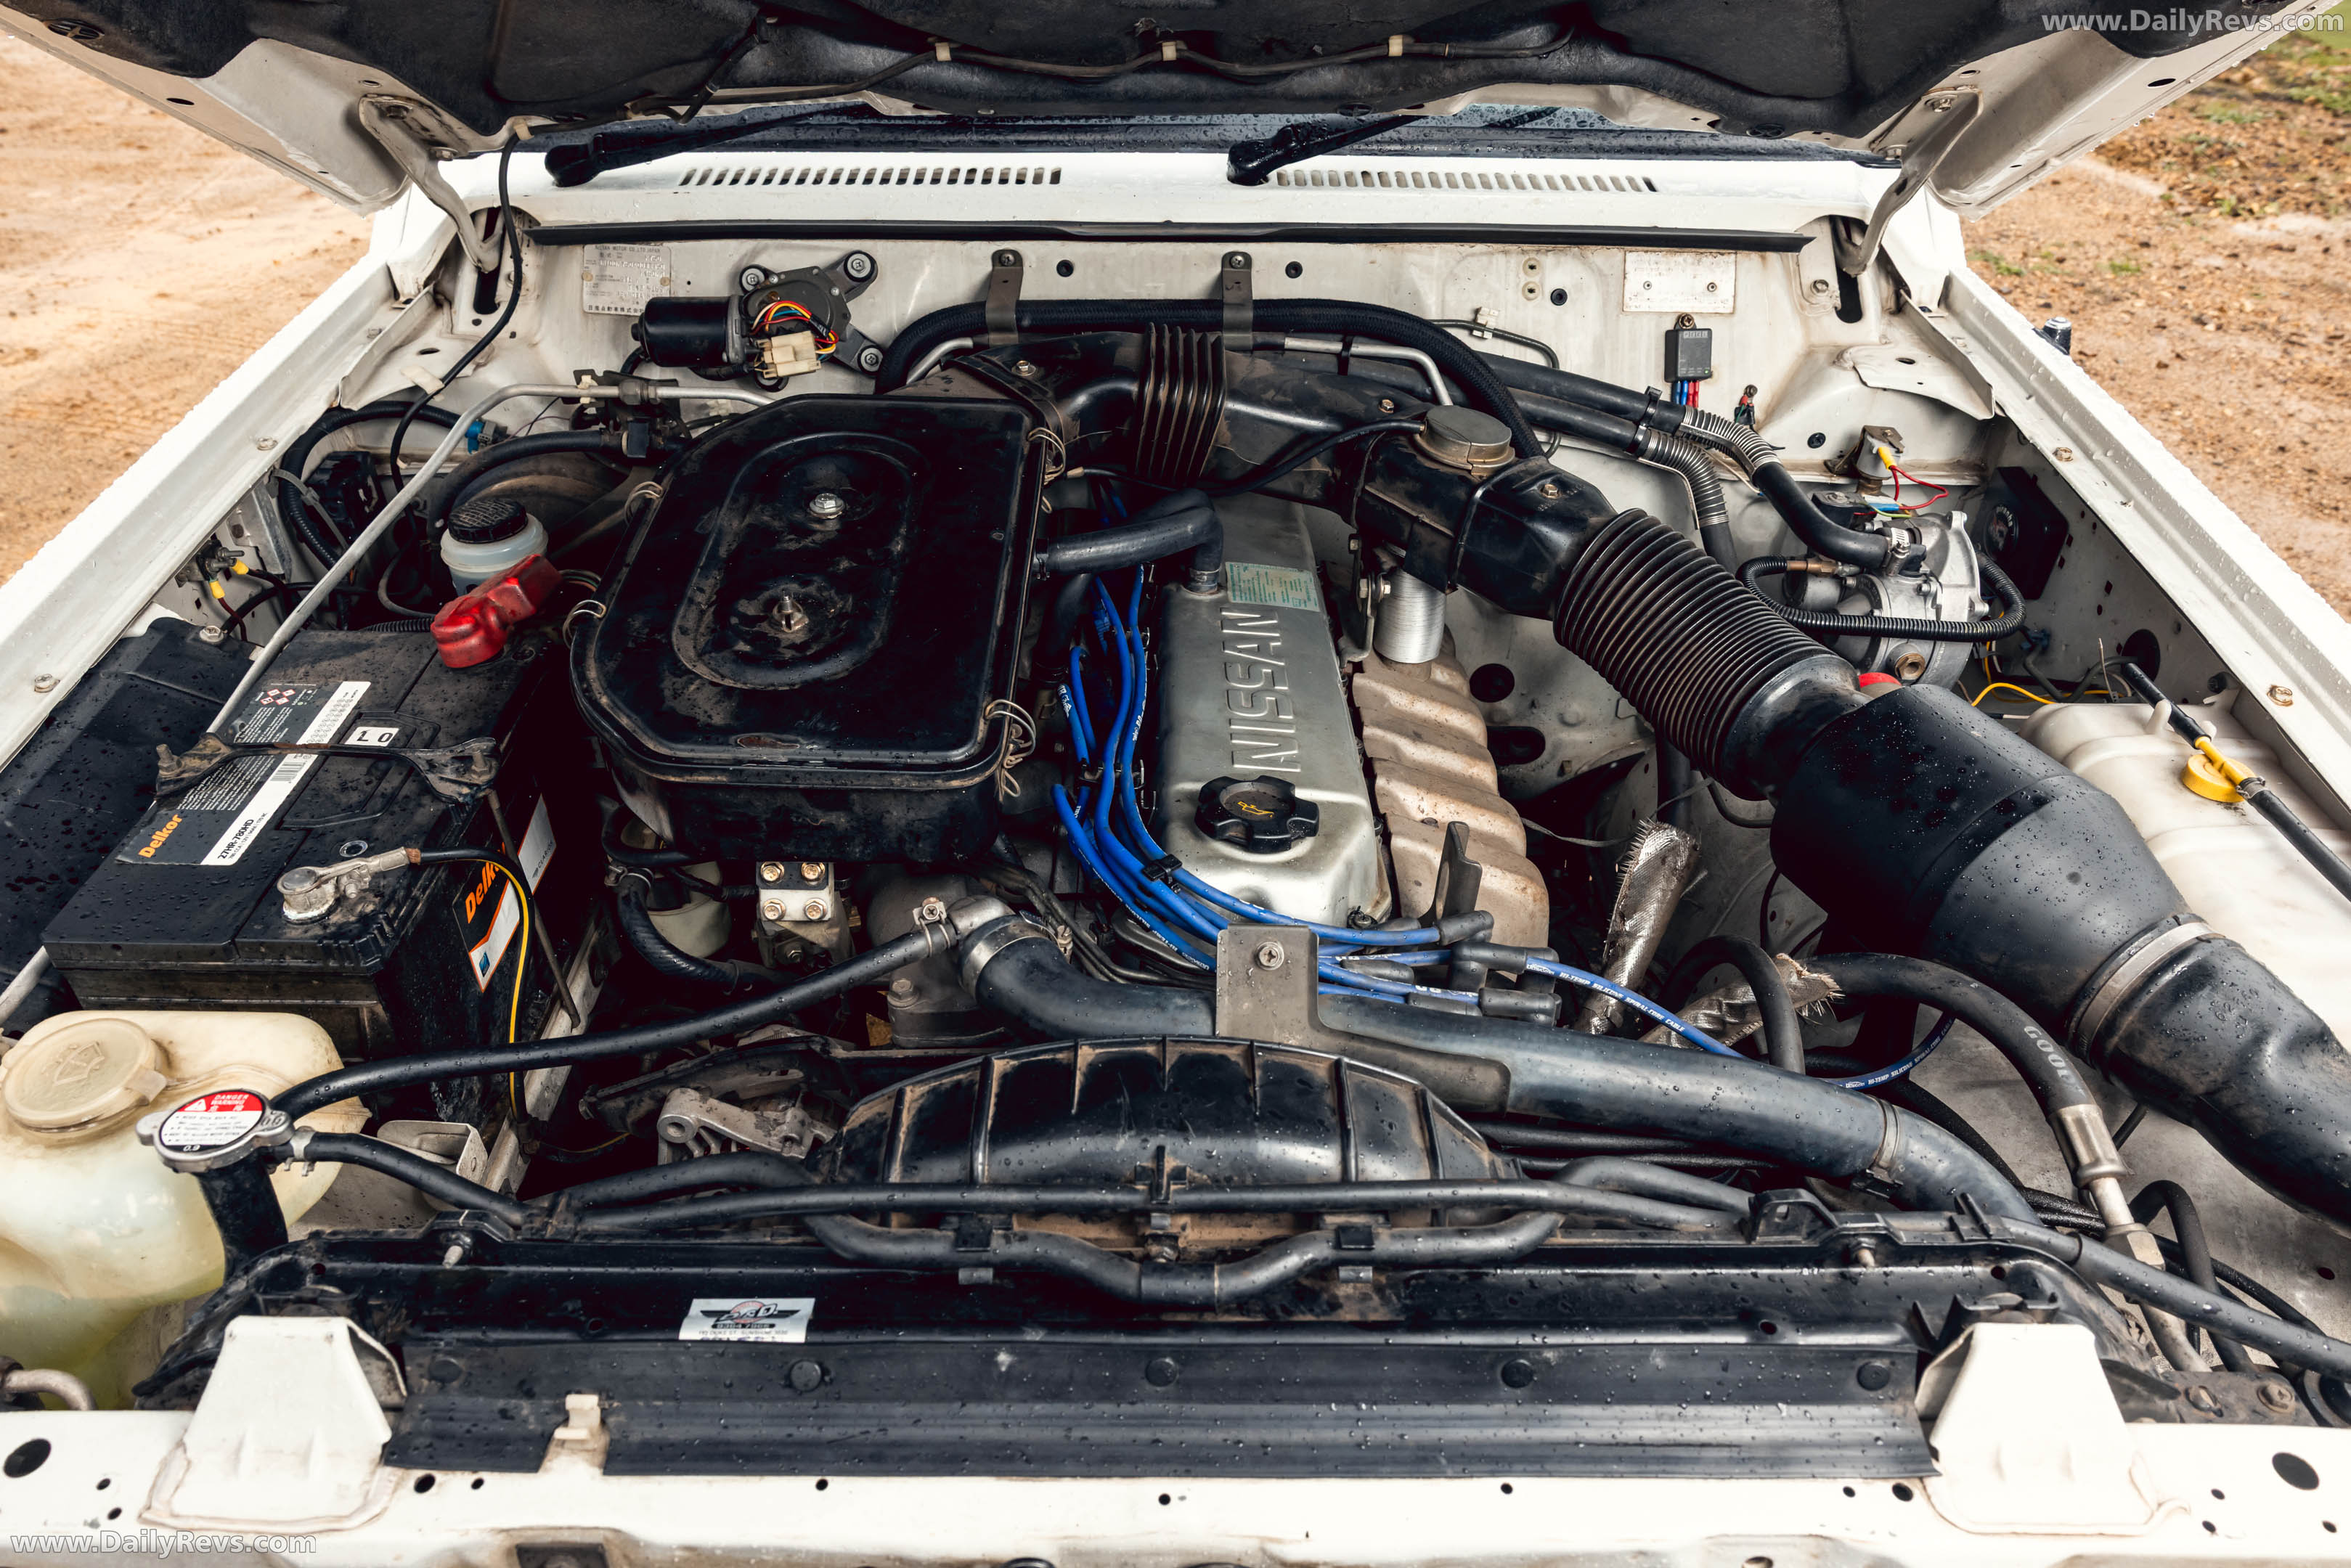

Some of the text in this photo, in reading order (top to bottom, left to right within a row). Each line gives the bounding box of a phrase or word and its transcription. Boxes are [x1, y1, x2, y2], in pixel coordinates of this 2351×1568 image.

[1220, 607, 1301, 772] NISSAN
[138, 814, 183, 859] Delkor
[218, 819, 254, 859] 27HR-780HD
[465, 842, 506, 924] Delk
[1559, 971, 1591, 985] HI-TEMP
[1592, 983, 1624, 999] SILICONE
[1626, 997, 1665, 1021] SPIRAL-CORE
[1665, 1018, 1685, 1032] CABLE
[1868, 1074, 1889, 1085] HI-TEMP
[1891, 1062, 1913, 1077] SILICONE
